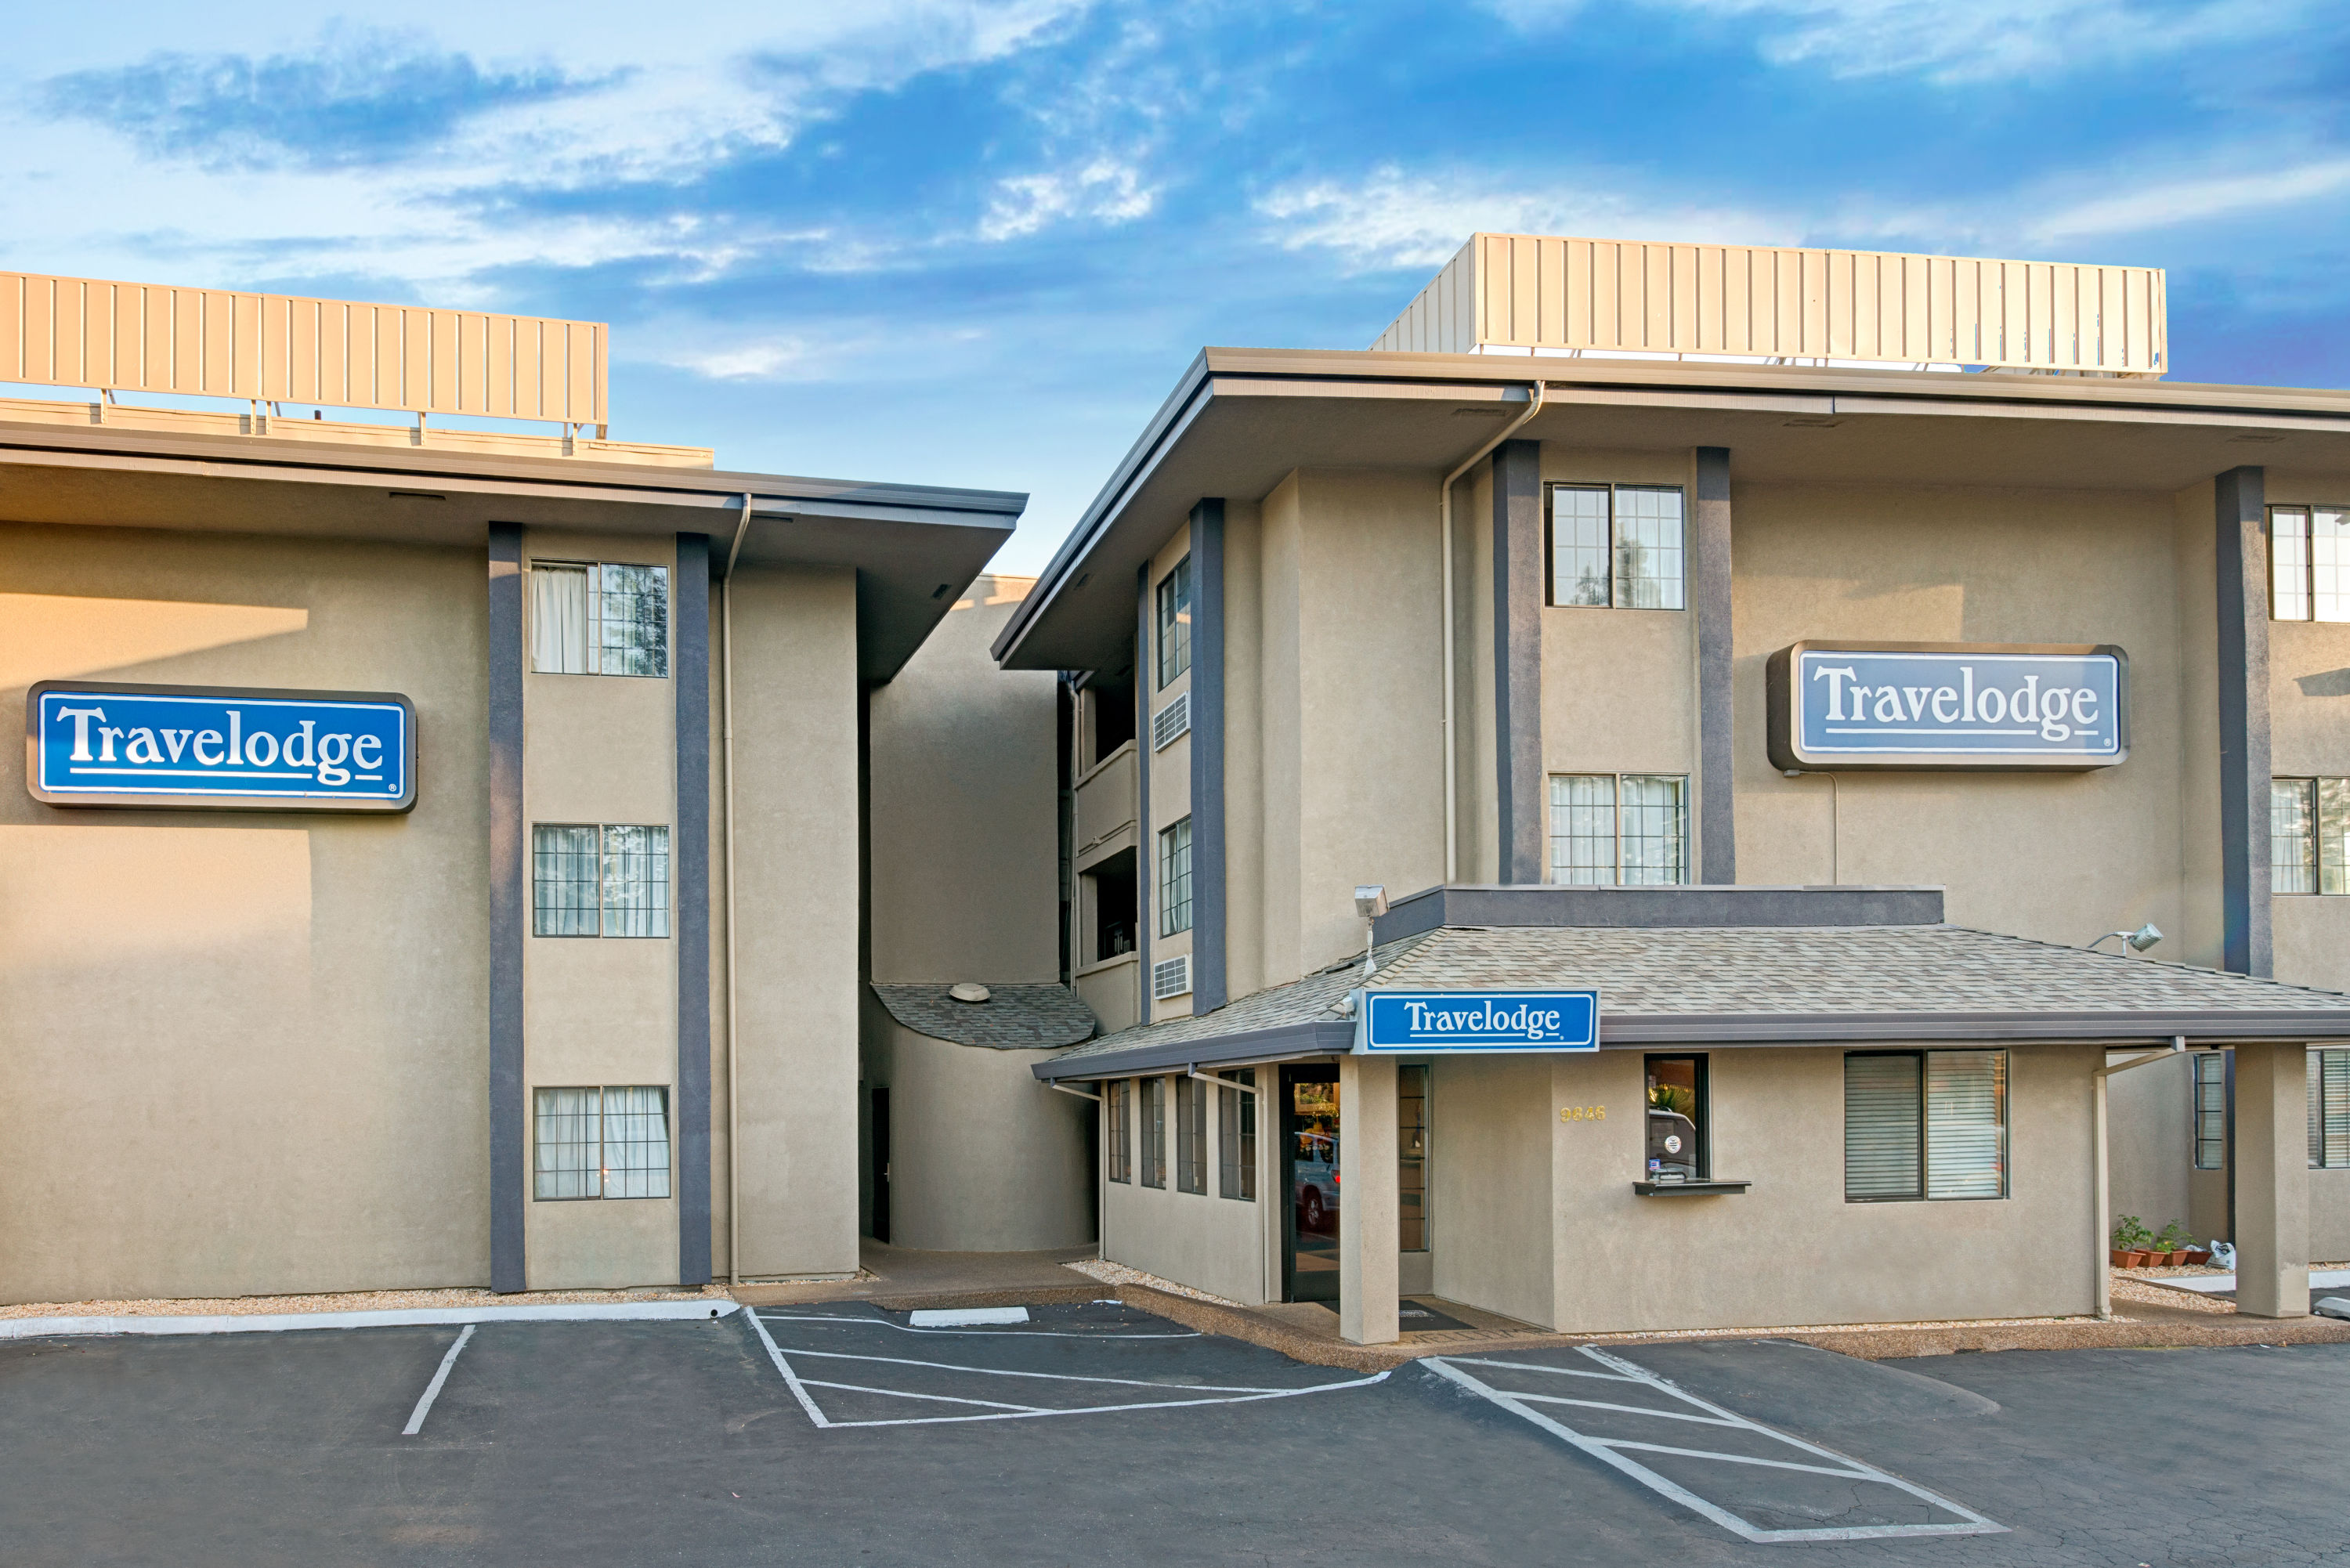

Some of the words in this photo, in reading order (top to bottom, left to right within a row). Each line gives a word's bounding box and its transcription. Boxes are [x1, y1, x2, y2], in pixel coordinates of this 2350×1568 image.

[1813, 665, 2099, 742] Travelodge
[56, 706, 383, 786] Travelodge
[1404, 1000, 1560, 1040] Travelodge
[1560, 1105, 1606, 1122] 9646
